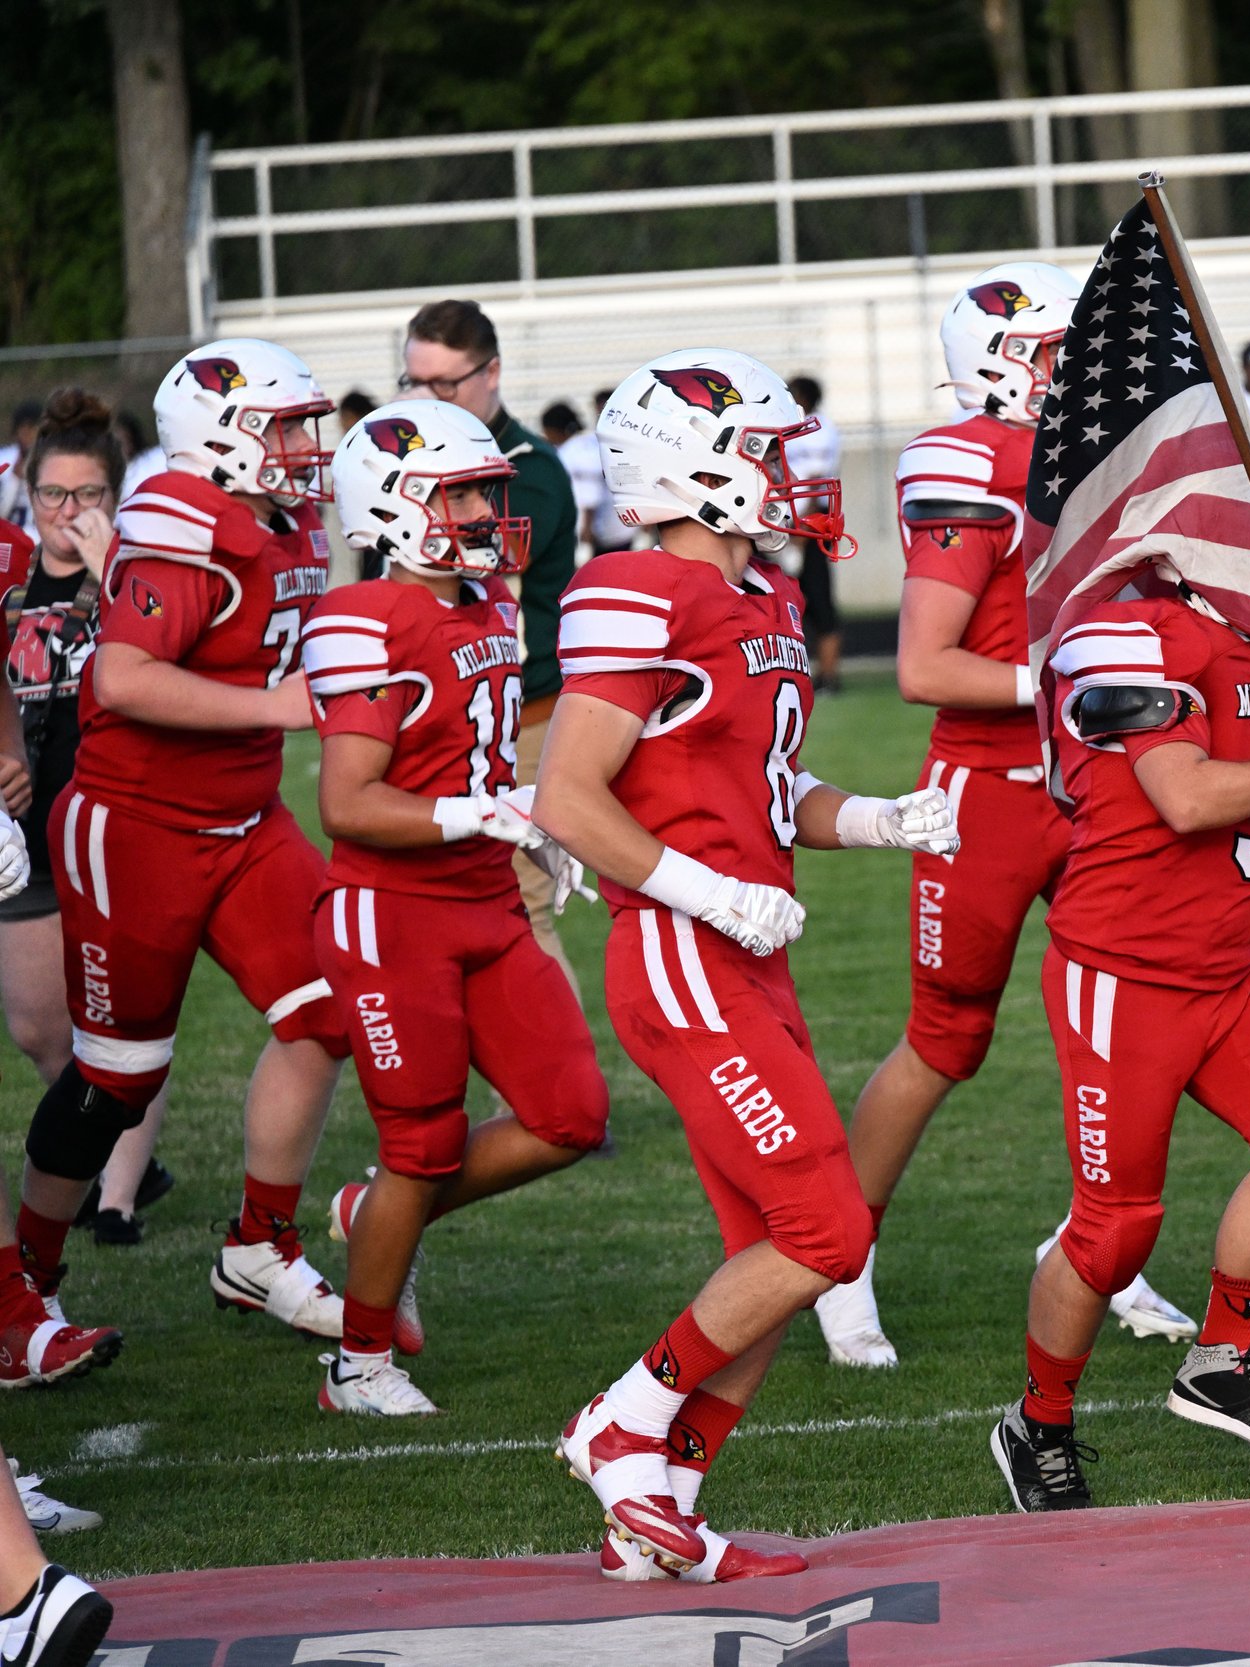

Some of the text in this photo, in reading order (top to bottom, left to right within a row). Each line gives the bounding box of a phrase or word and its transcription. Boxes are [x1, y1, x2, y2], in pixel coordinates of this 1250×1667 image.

[740, 633, 812, 677] MILLINGTO
[466, 672, 524, 798] 19
[764, 677, 804, 851] 8
[919, 879, 945, 970] CARDS
[81, 941, 115, 1026] CARDS
[356, 992, 403, 1071] CARDS
[709, 1055, 798, 1156] CARDS
[1076, 1084, 1111, 1184] CARDS
